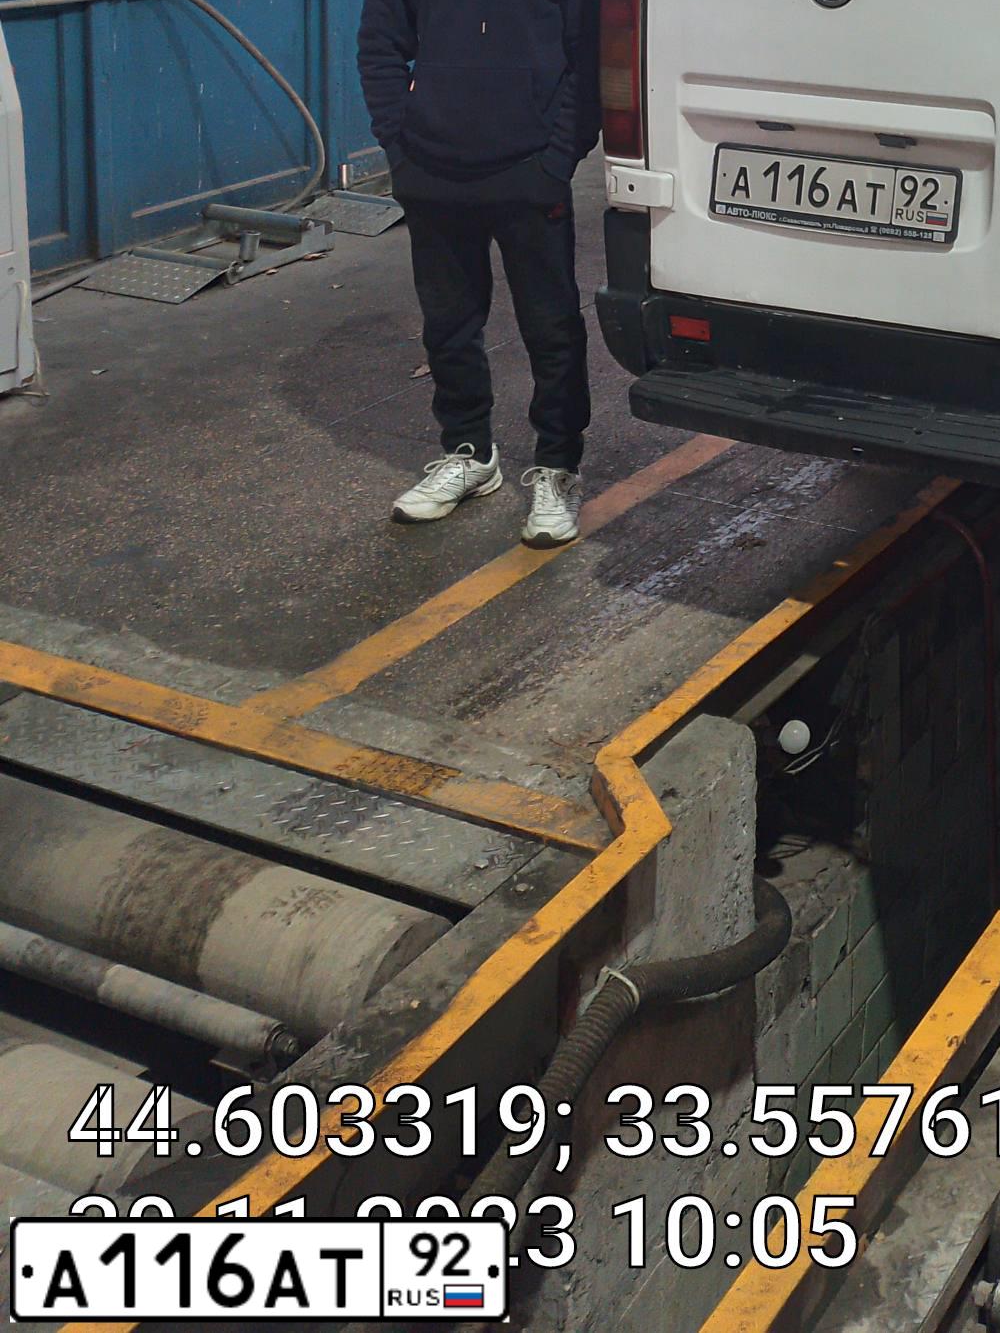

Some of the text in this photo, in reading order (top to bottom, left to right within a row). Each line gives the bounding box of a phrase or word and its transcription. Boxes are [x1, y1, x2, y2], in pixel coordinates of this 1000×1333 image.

[730, 160, 940, 215] А116АТ 92
[726, 206, 777, 221] АВТО-ЛЮКС
[895, 207, 925, 223] RUS
